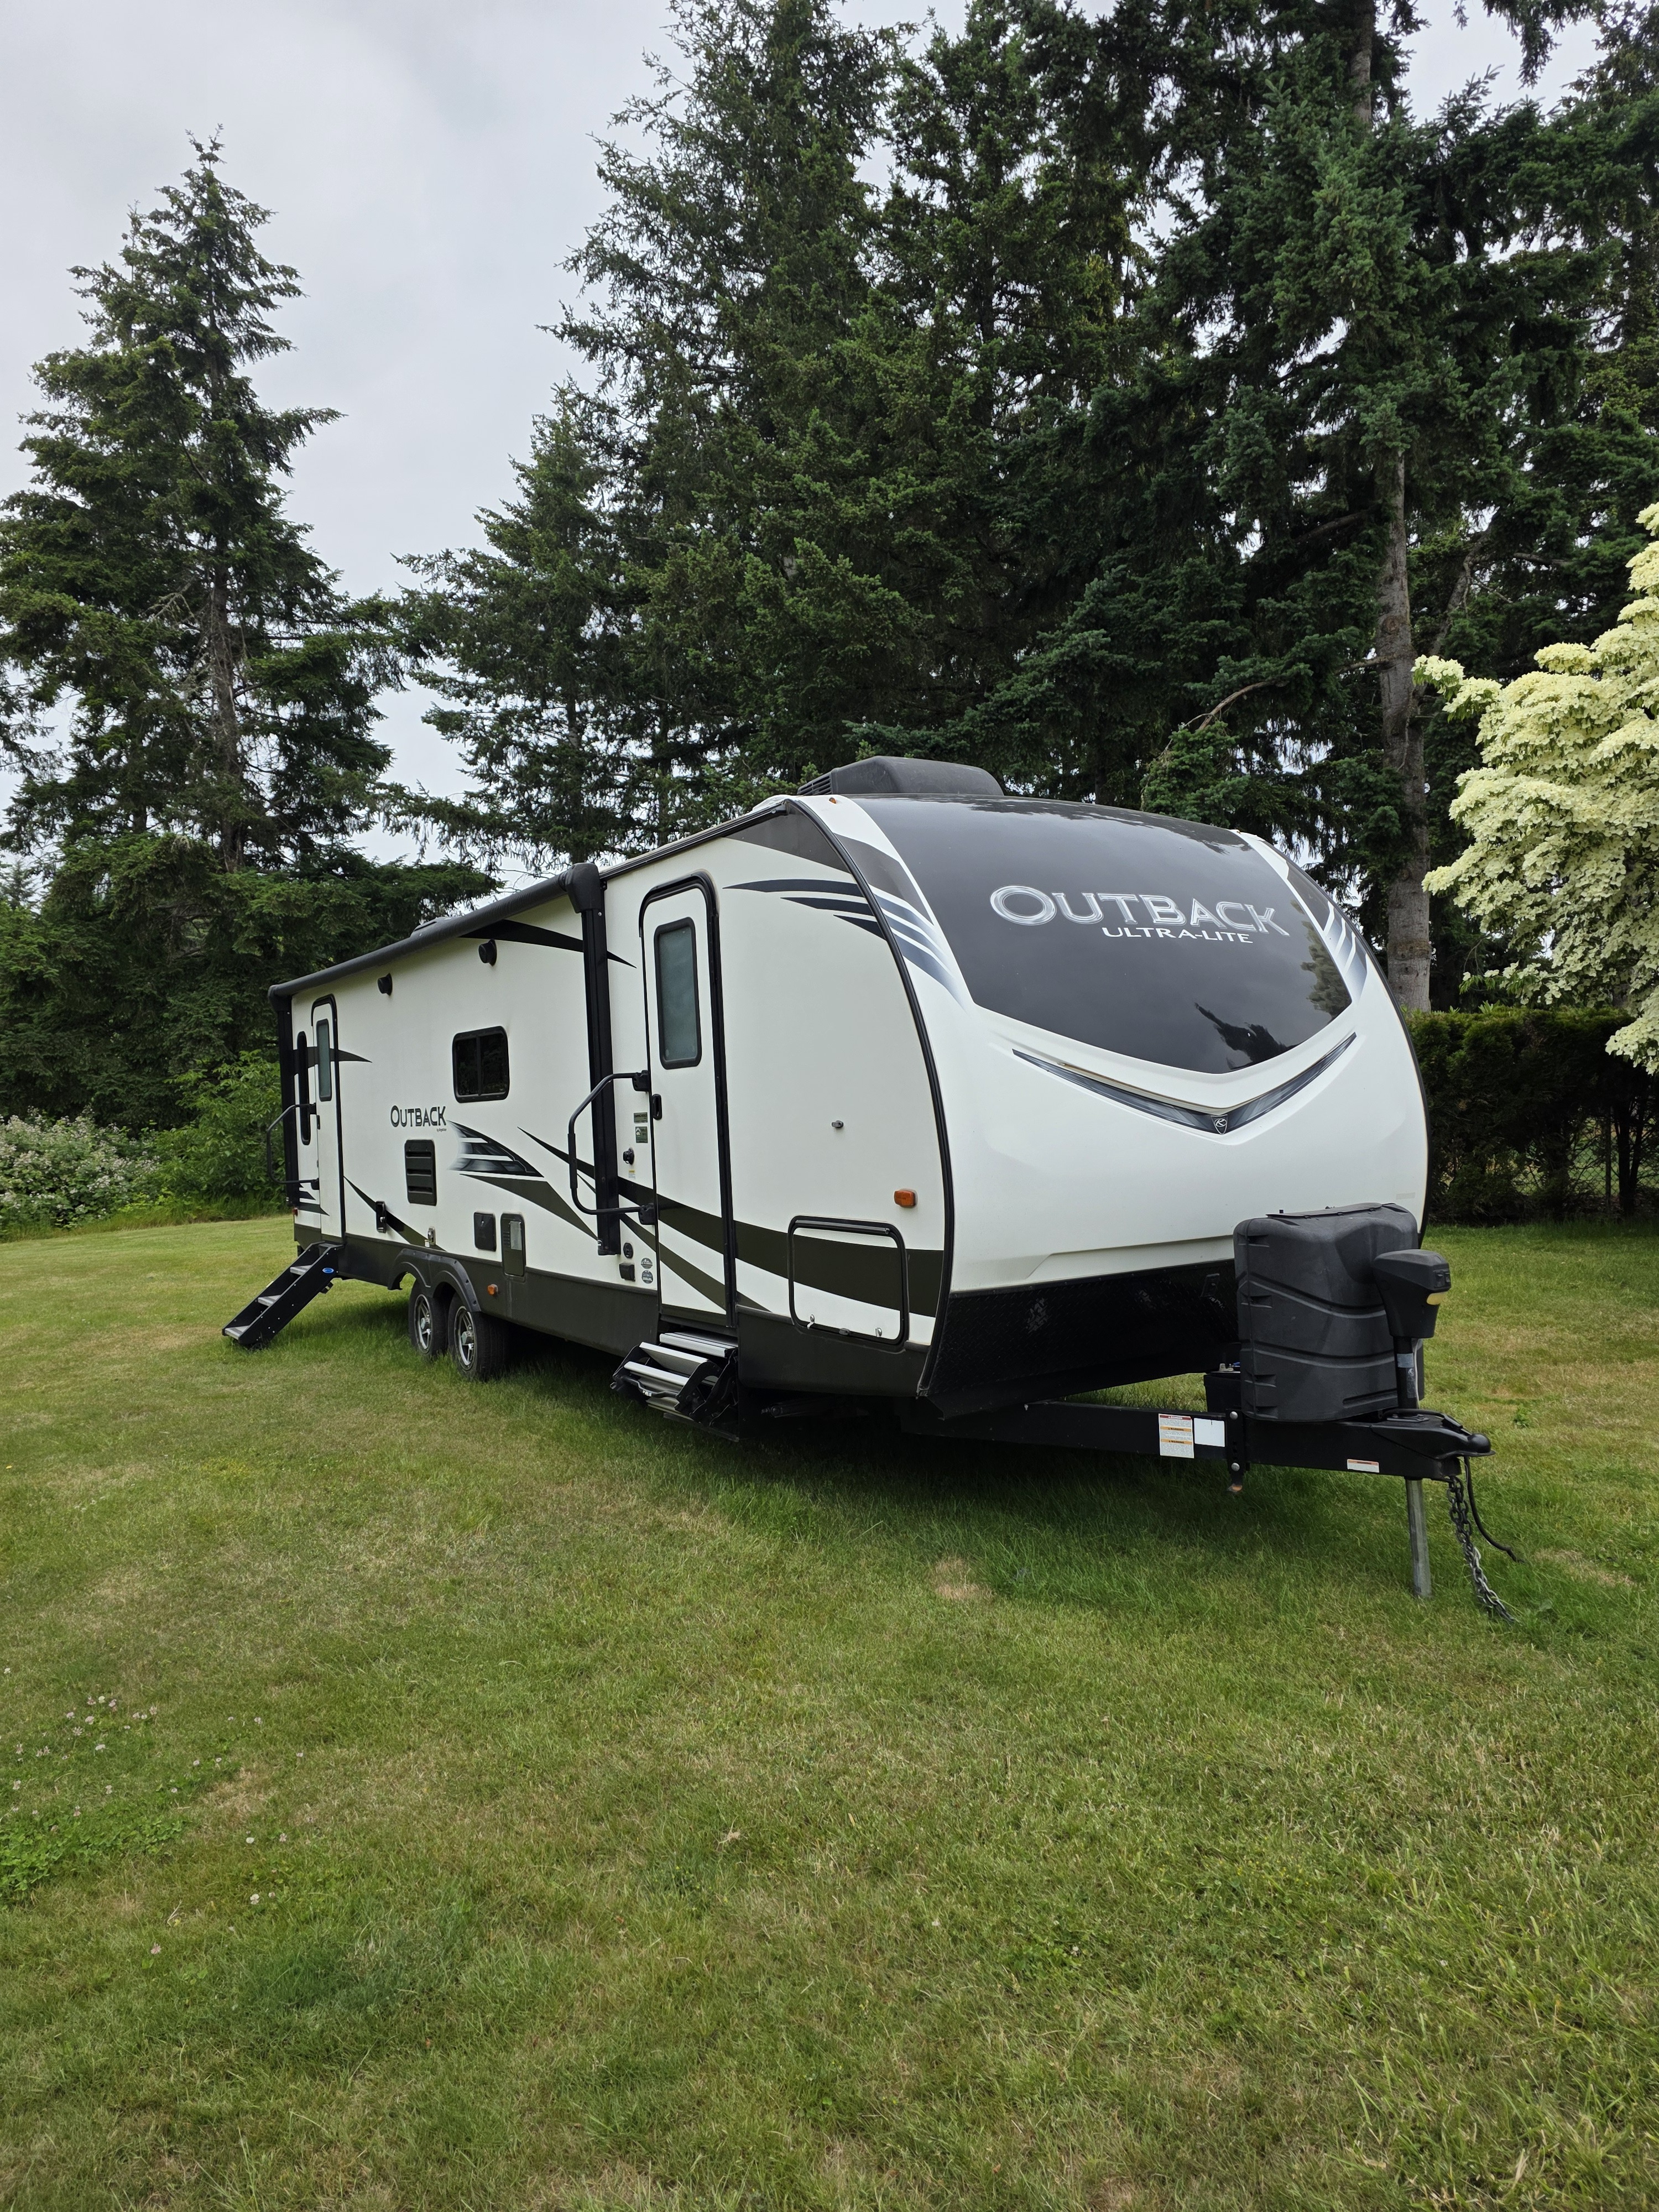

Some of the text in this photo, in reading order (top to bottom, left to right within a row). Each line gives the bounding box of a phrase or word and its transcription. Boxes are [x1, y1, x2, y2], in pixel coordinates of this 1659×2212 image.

[990, 885, 1290, 937] OUTBACK
[1102, 927, 1254, 943] ULTRA-LITE
[390, 1105, 446, 1127] OUTBACK
